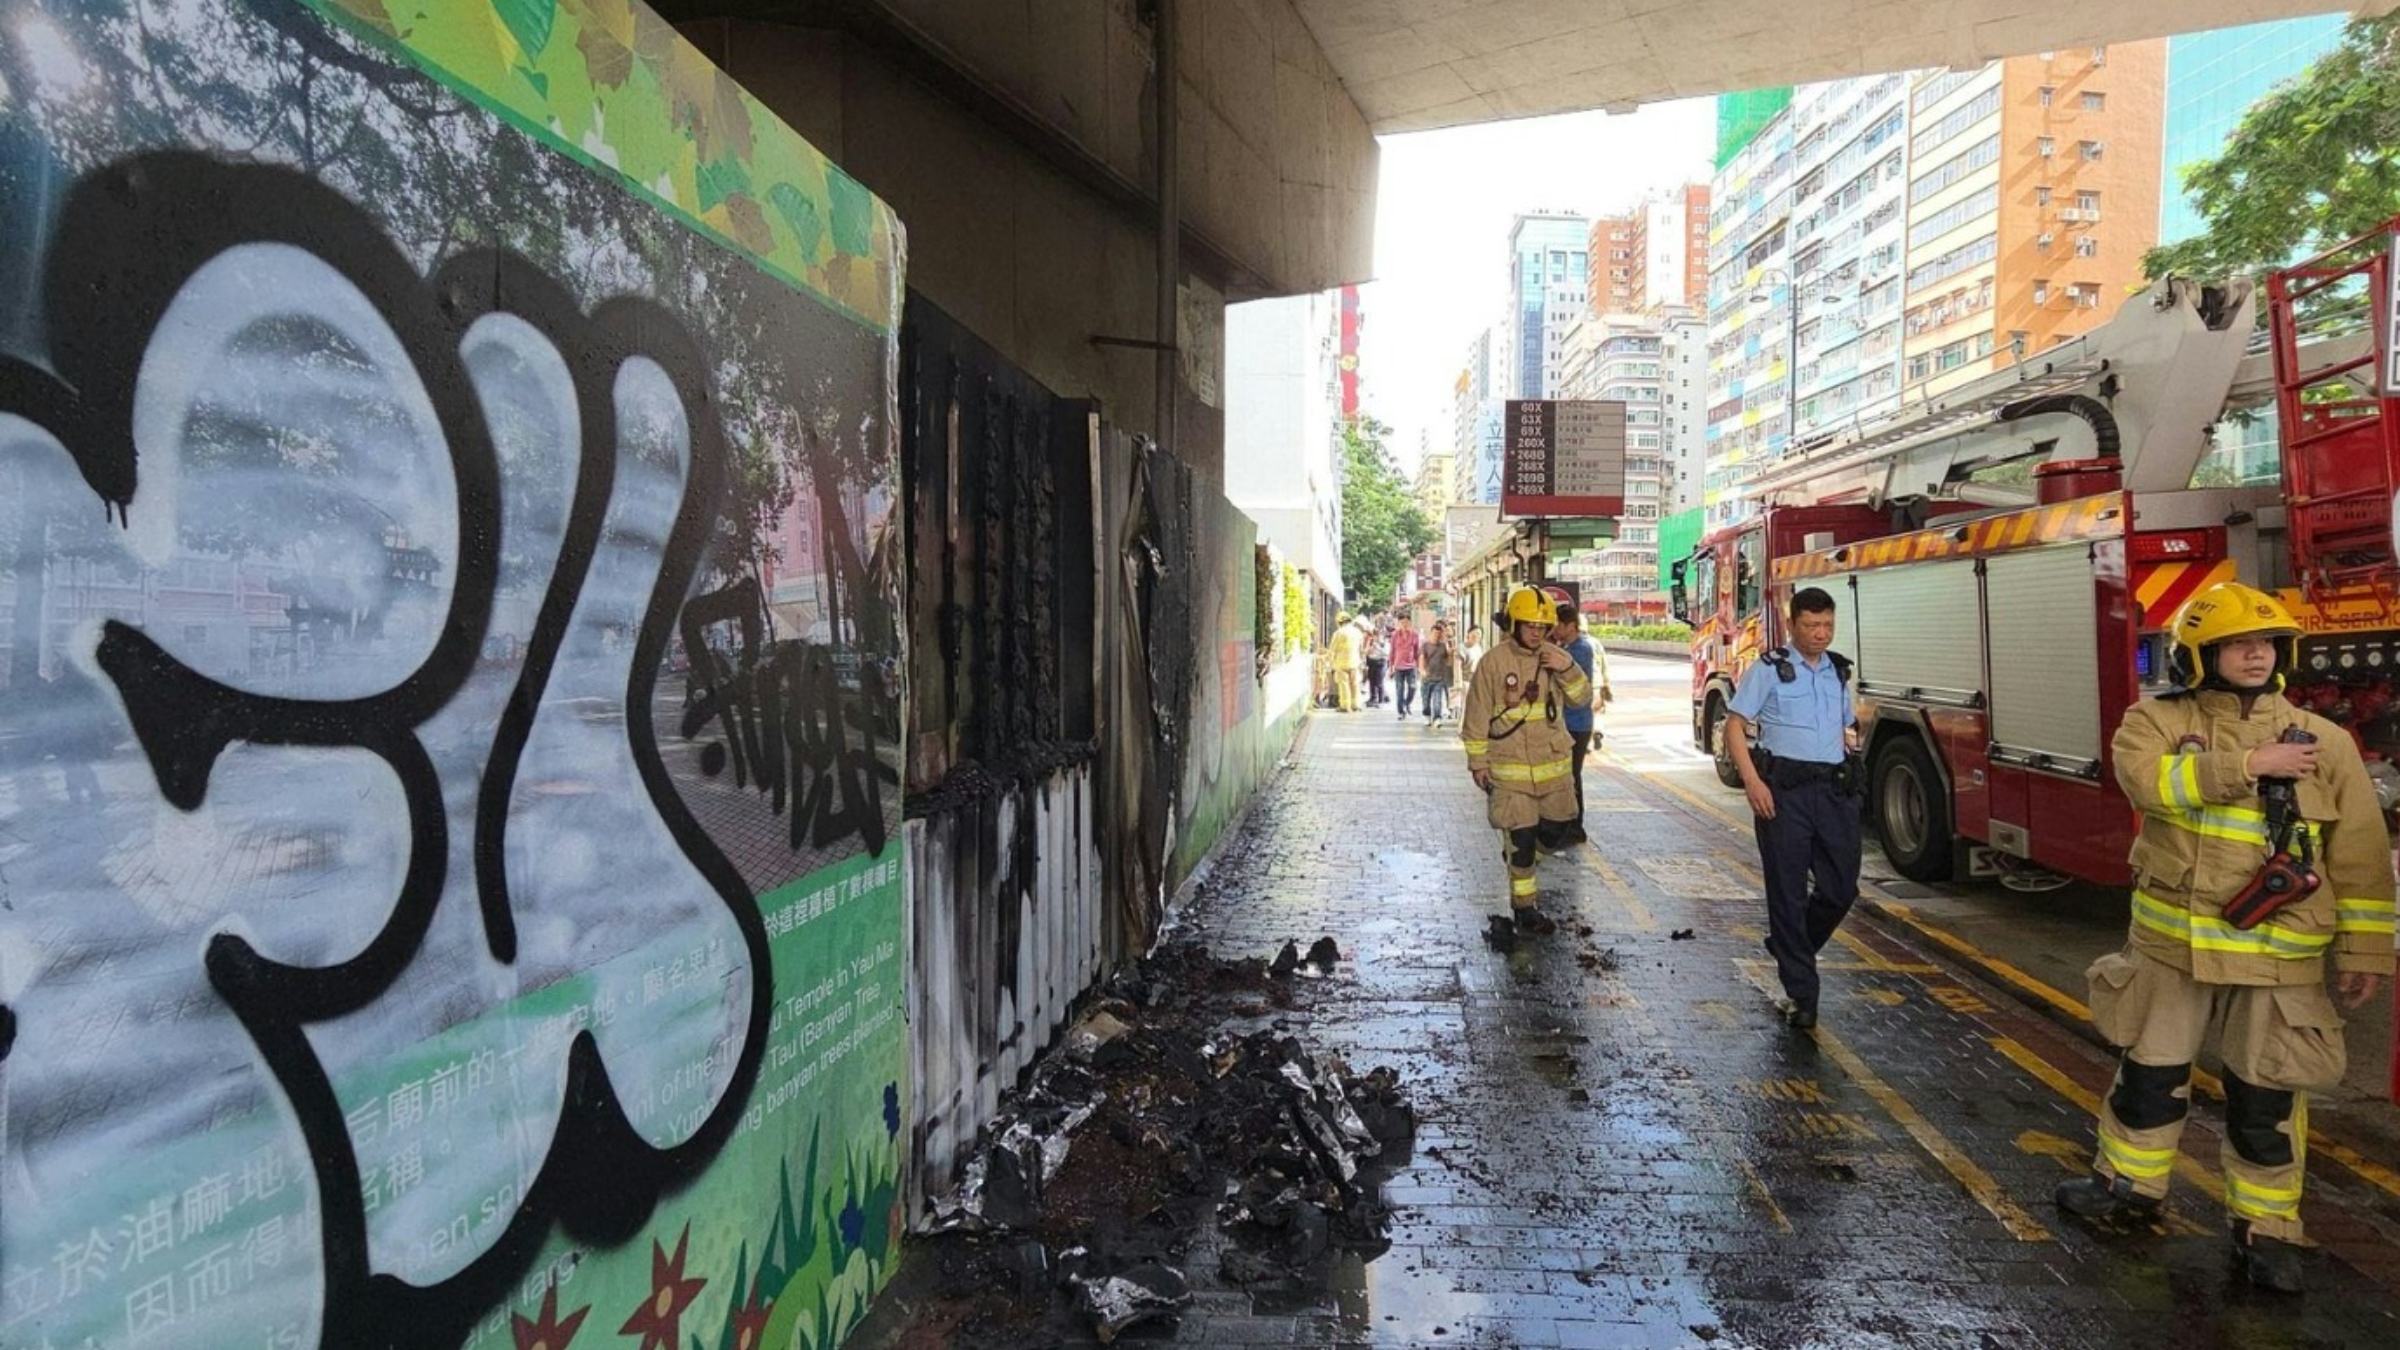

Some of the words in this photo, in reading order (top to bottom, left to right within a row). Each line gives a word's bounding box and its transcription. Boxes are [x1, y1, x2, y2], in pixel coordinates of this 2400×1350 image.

[1521, 402, 1543, 413] 60X
[1521, 413, 1543, 425] 63X
[661, 1067, 681, 1106] of
[685, 1055, 714, 1090] the
[785, 975, 834, 1021] Temple
[836, 966, 849, 989] in
[850, 953, 874, 980] Yau
[876, 941, 893, 965] Ma
[766, 1060, 817, 1114] banyan
[819, 1033, 851, 1071] trees
[852, 998, 893, 1052] planted
[768, 1038, 797, 1071] Tau
[801, 1001, 852, 1055] (Banyan
[853, 981, 880, 1010] Tree
